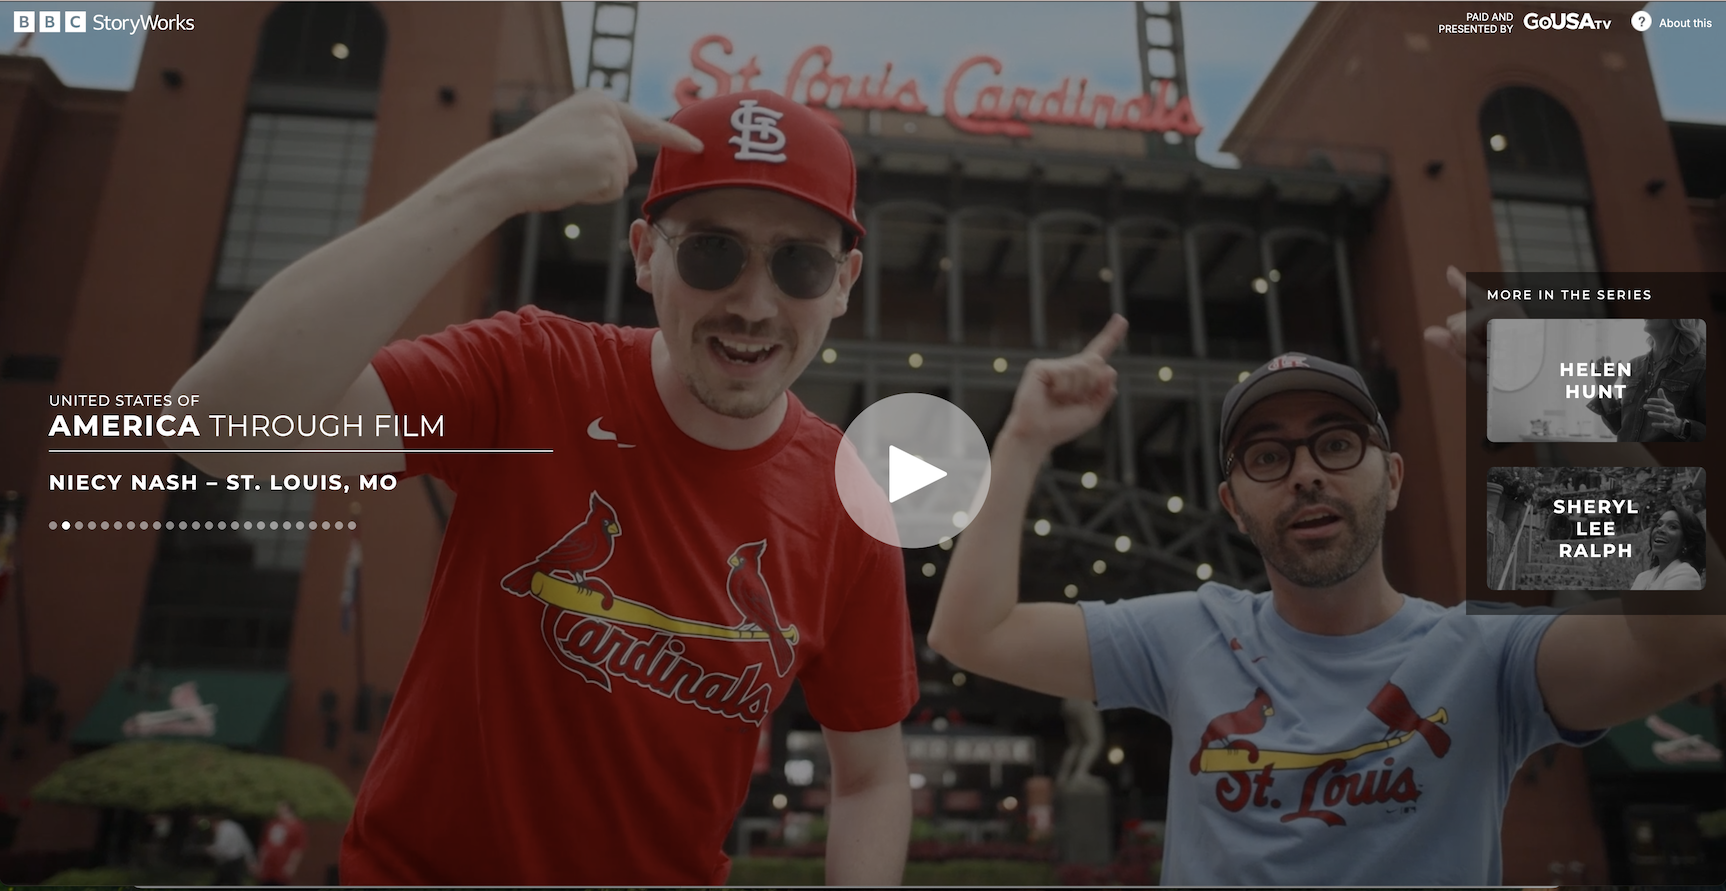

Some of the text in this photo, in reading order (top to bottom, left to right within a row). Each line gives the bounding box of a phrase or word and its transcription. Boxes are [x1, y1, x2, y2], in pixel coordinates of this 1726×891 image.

[784, 44, 929, 129] Louis
[943, 54, 1204, 137] Cardinals
[540, 577, 772, 728] Cardinals
[1280, 757, 1424, 828] Louis
